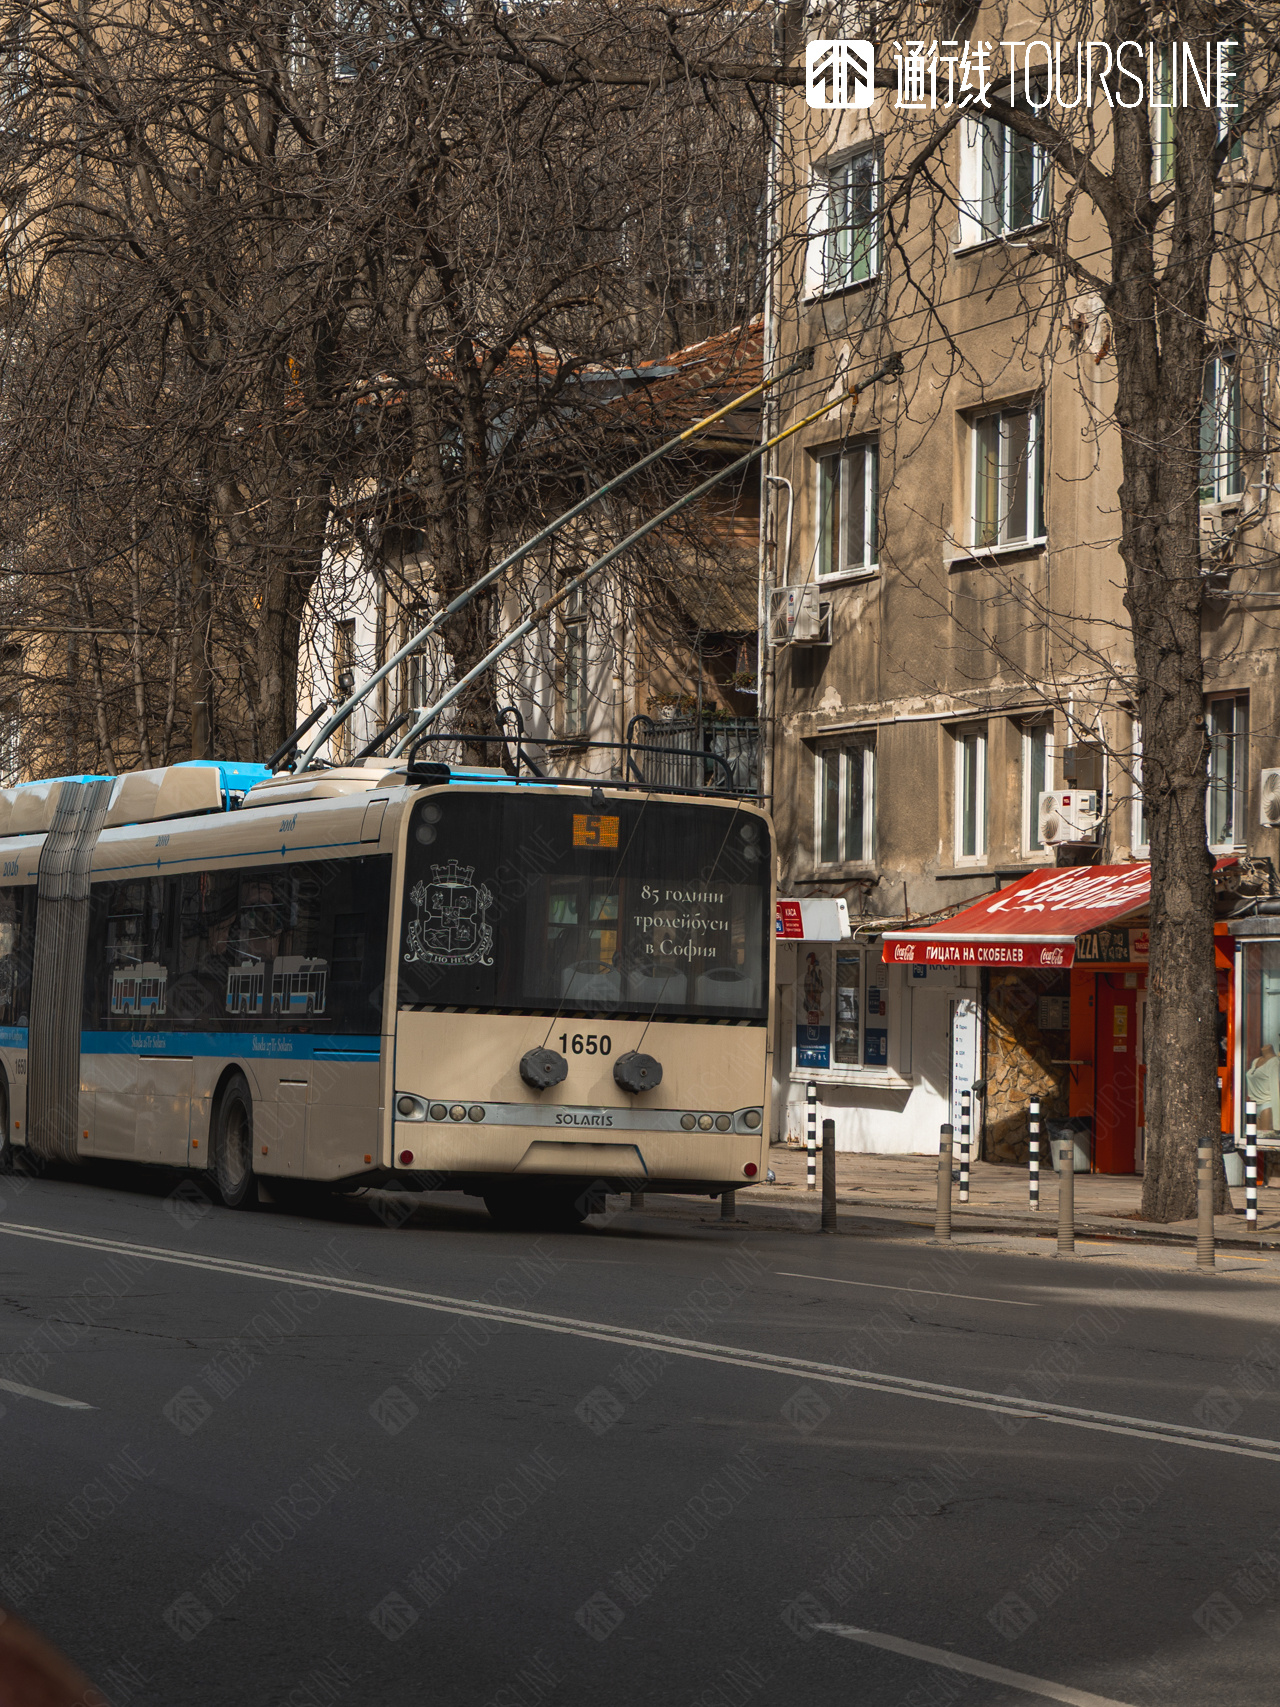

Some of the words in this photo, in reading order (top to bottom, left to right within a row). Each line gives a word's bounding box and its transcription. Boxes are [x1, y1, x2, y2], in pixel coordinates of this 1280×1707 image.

[584, 817, 601, 844] 5
[2, 852, 21, 877] 2026
[640, 884, 659, 905] 85
[665, 890, 724, 905] години
[634, 912, 729, 934] тролейбуси
[645, 943, 655, 955] в
[659, 940, 716, 962] София
[926, 946, 960, 962] ПИЦАТА
[963, 948, 975, 960] НА
[978, 947, 1024, 962] СКОБЕЛЕВ
[1077, 934, 1098, 959] IZZA
[558, 1033, 612, 1056] 1650
[555, 1114, 614, 1127] SOLARIS
